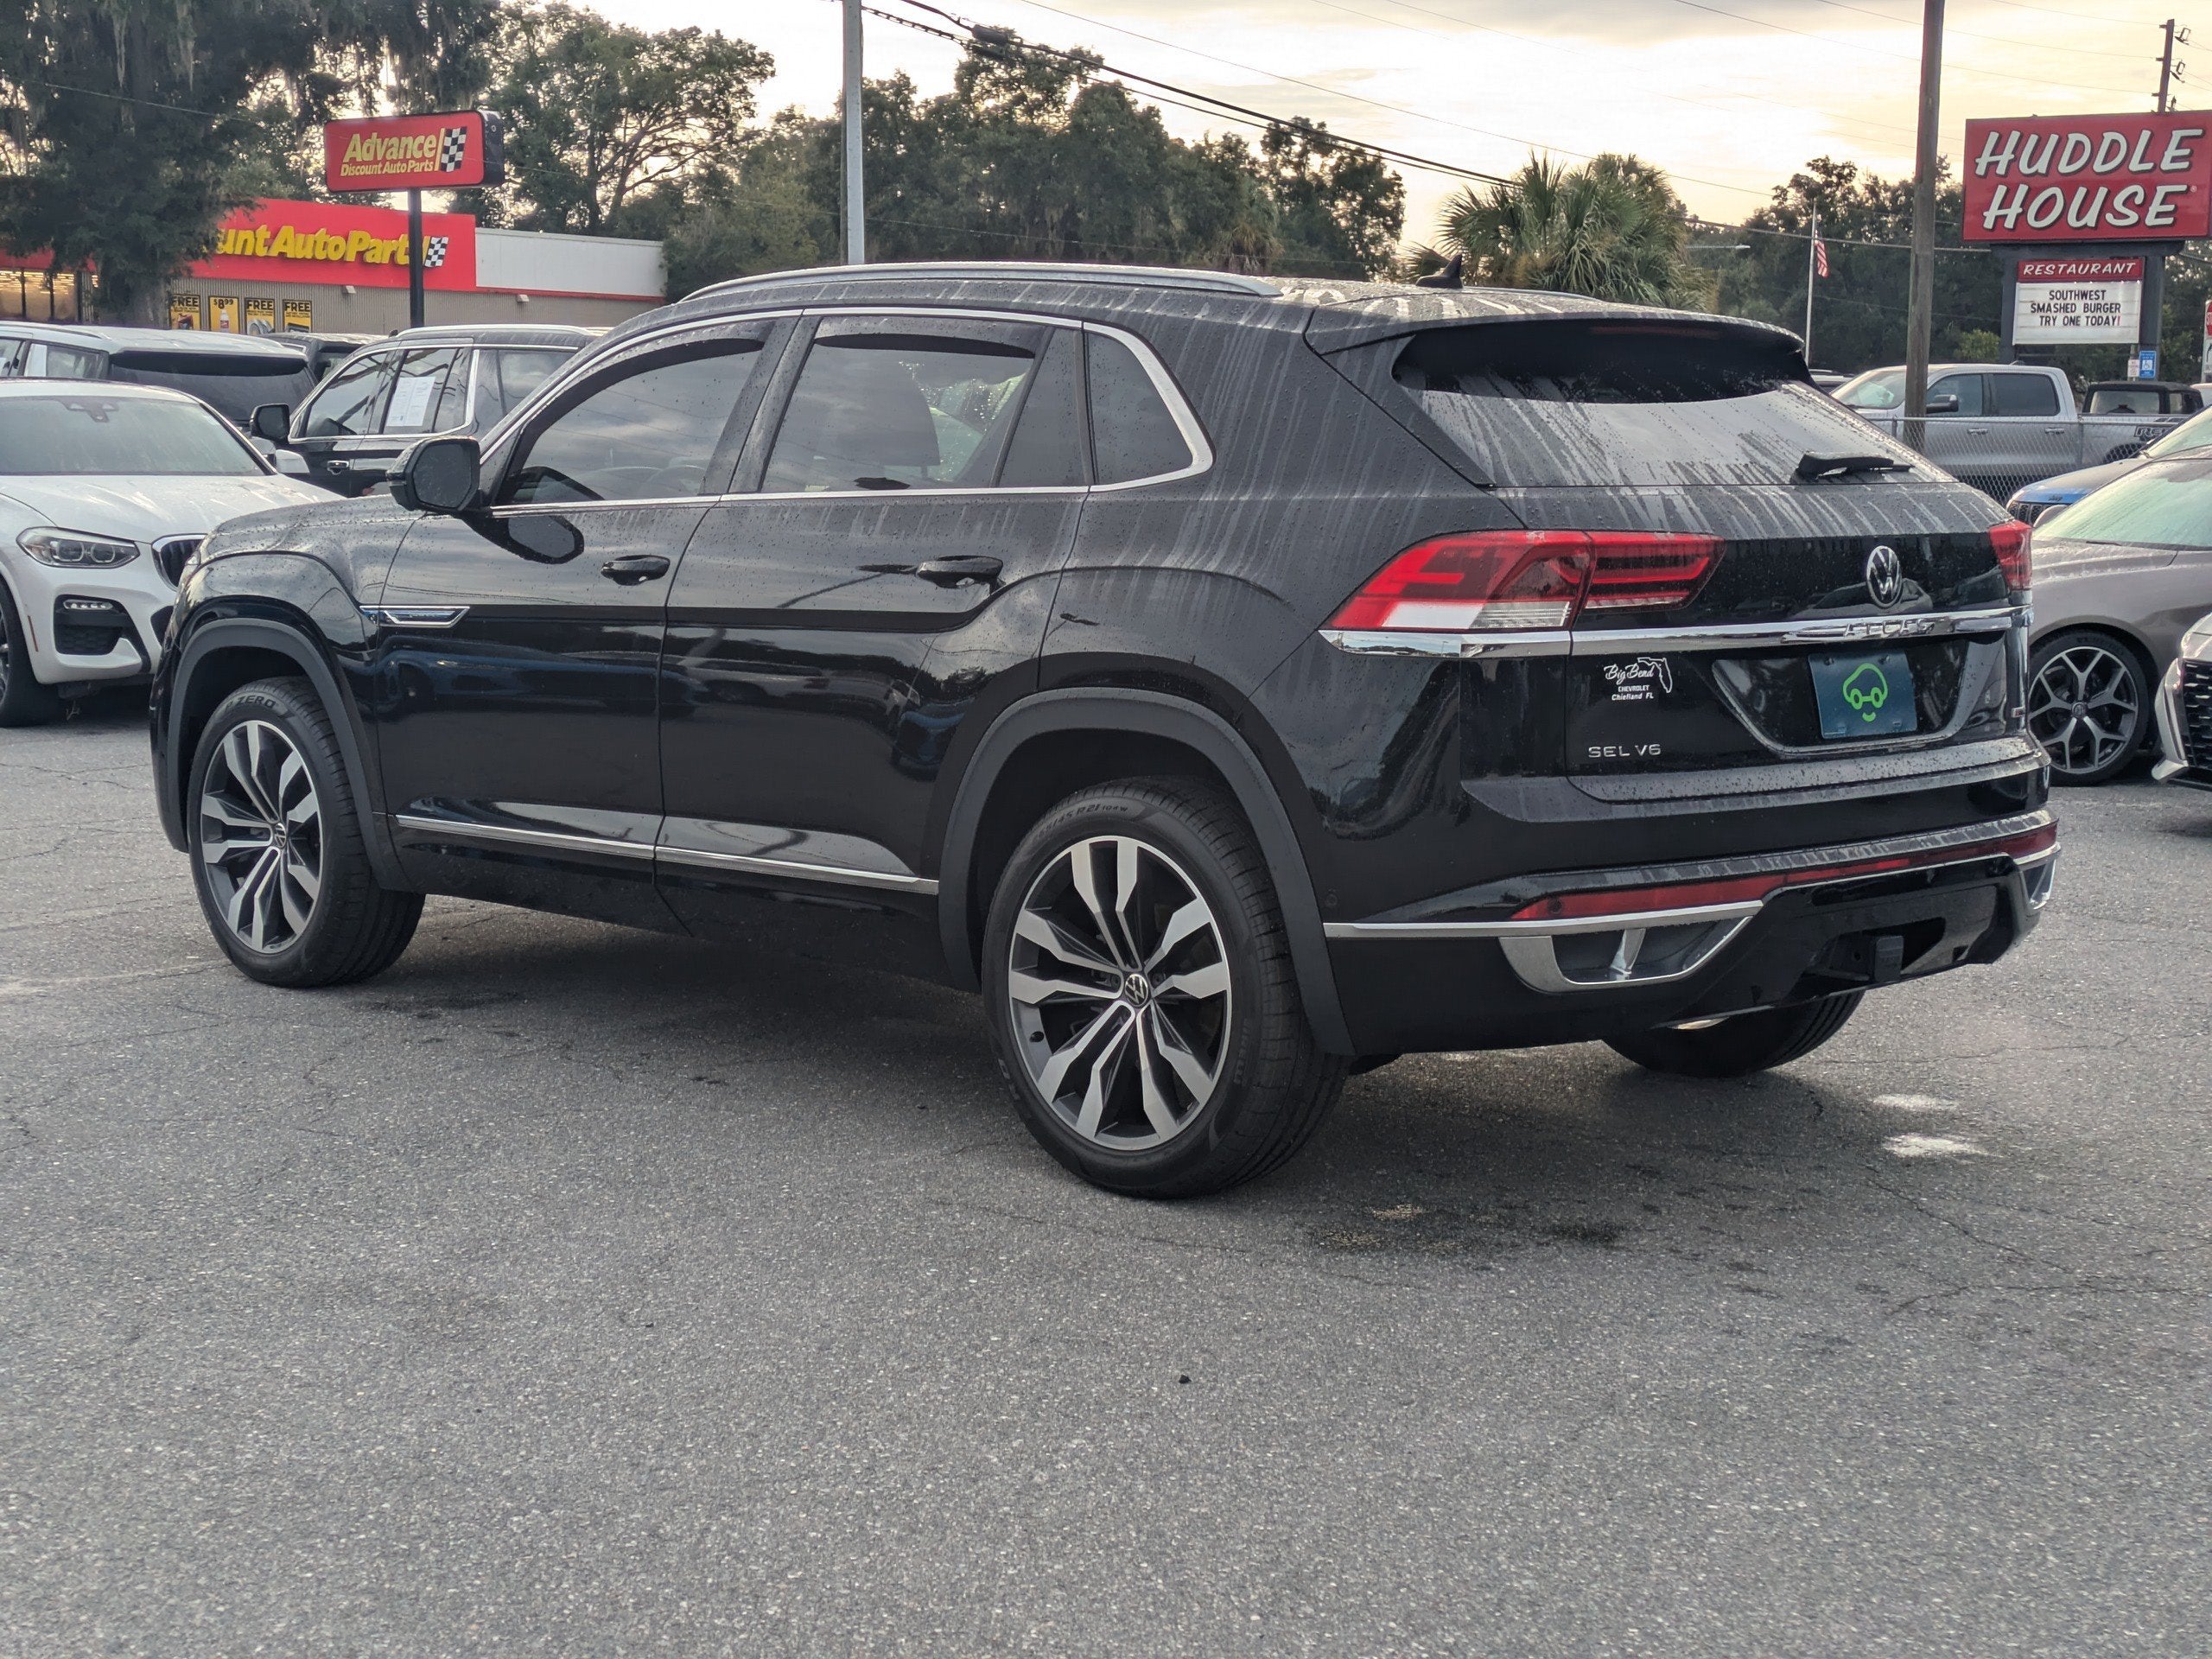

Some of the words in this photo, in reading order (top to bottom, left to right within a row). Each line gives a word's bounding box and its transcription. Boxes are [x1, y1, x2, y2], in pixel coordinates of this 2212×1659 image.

[343, 132, 436, 162] Advance
[1975, 129, 2202, 175] HUDDLE
[340, 162, 384, 176] Discount
[1983, 183, 2188, 230] HOUSE
[2023, 262, 2136, 276] RESTAURANT
[2049, 289, 2107, 301] SOUTHWEST
[247, 300, 273, 311] FREE
[285, 302, 310, 313] FREE
[2031, 302, 2077, 314] SMASHED
[2083, 302, 2121, 314] BURGER
[2039, 315, 2056, 327] TRY
[2063, 315, 2082, 327] ONE
[2085, 315, 2121, 327] TODAY!
[1604, 663, 1626, 685] Big
[1624, 663, 1655, 679] Bend
[1618, 684, 1649, 693] CHEVROLET
[237, 695, 276, 709] ZERO
[1611, 692, 1643, 701] Chiefland
[1588, 746, 1630, 758] SEL
[1634, 744, 1661, 757] V6
